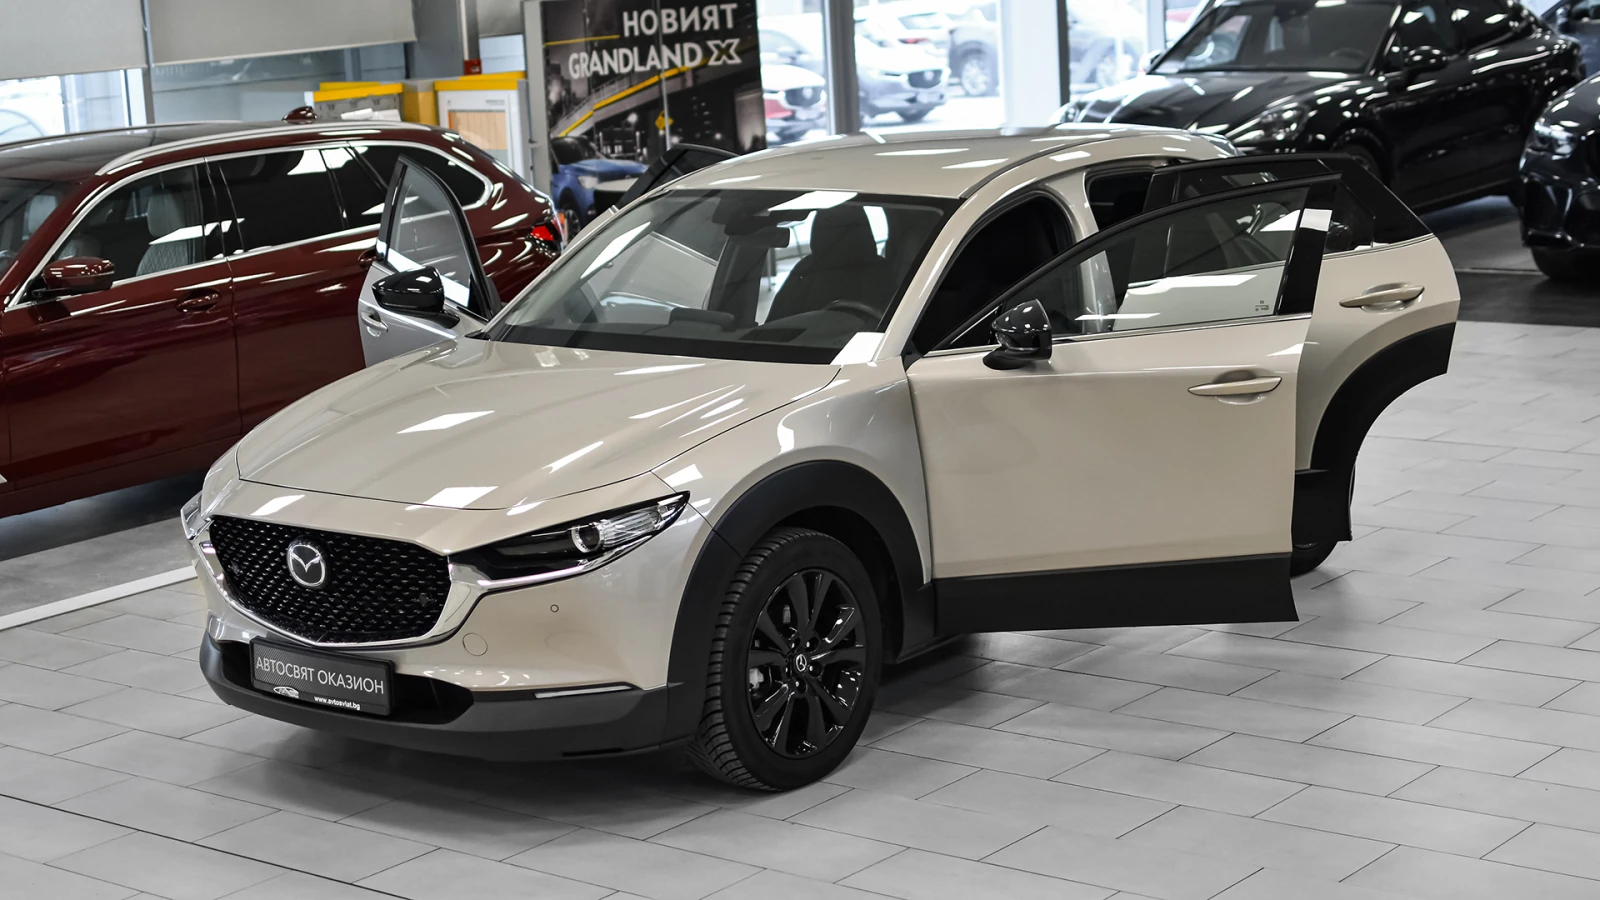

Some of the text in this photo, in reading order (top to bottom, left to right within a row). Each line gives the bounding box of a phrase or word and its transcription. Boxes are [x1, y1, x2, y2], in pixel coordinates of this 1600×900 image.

[623, 3, 738, 38] НОВИЯТ
[568, 38, 742, 79] GRANDLAND X
[256, 657, 384, 695] АВТОСВЯТ ОКАЗИОН
[314, 696, 361, 711] www.avtosviat.bg
